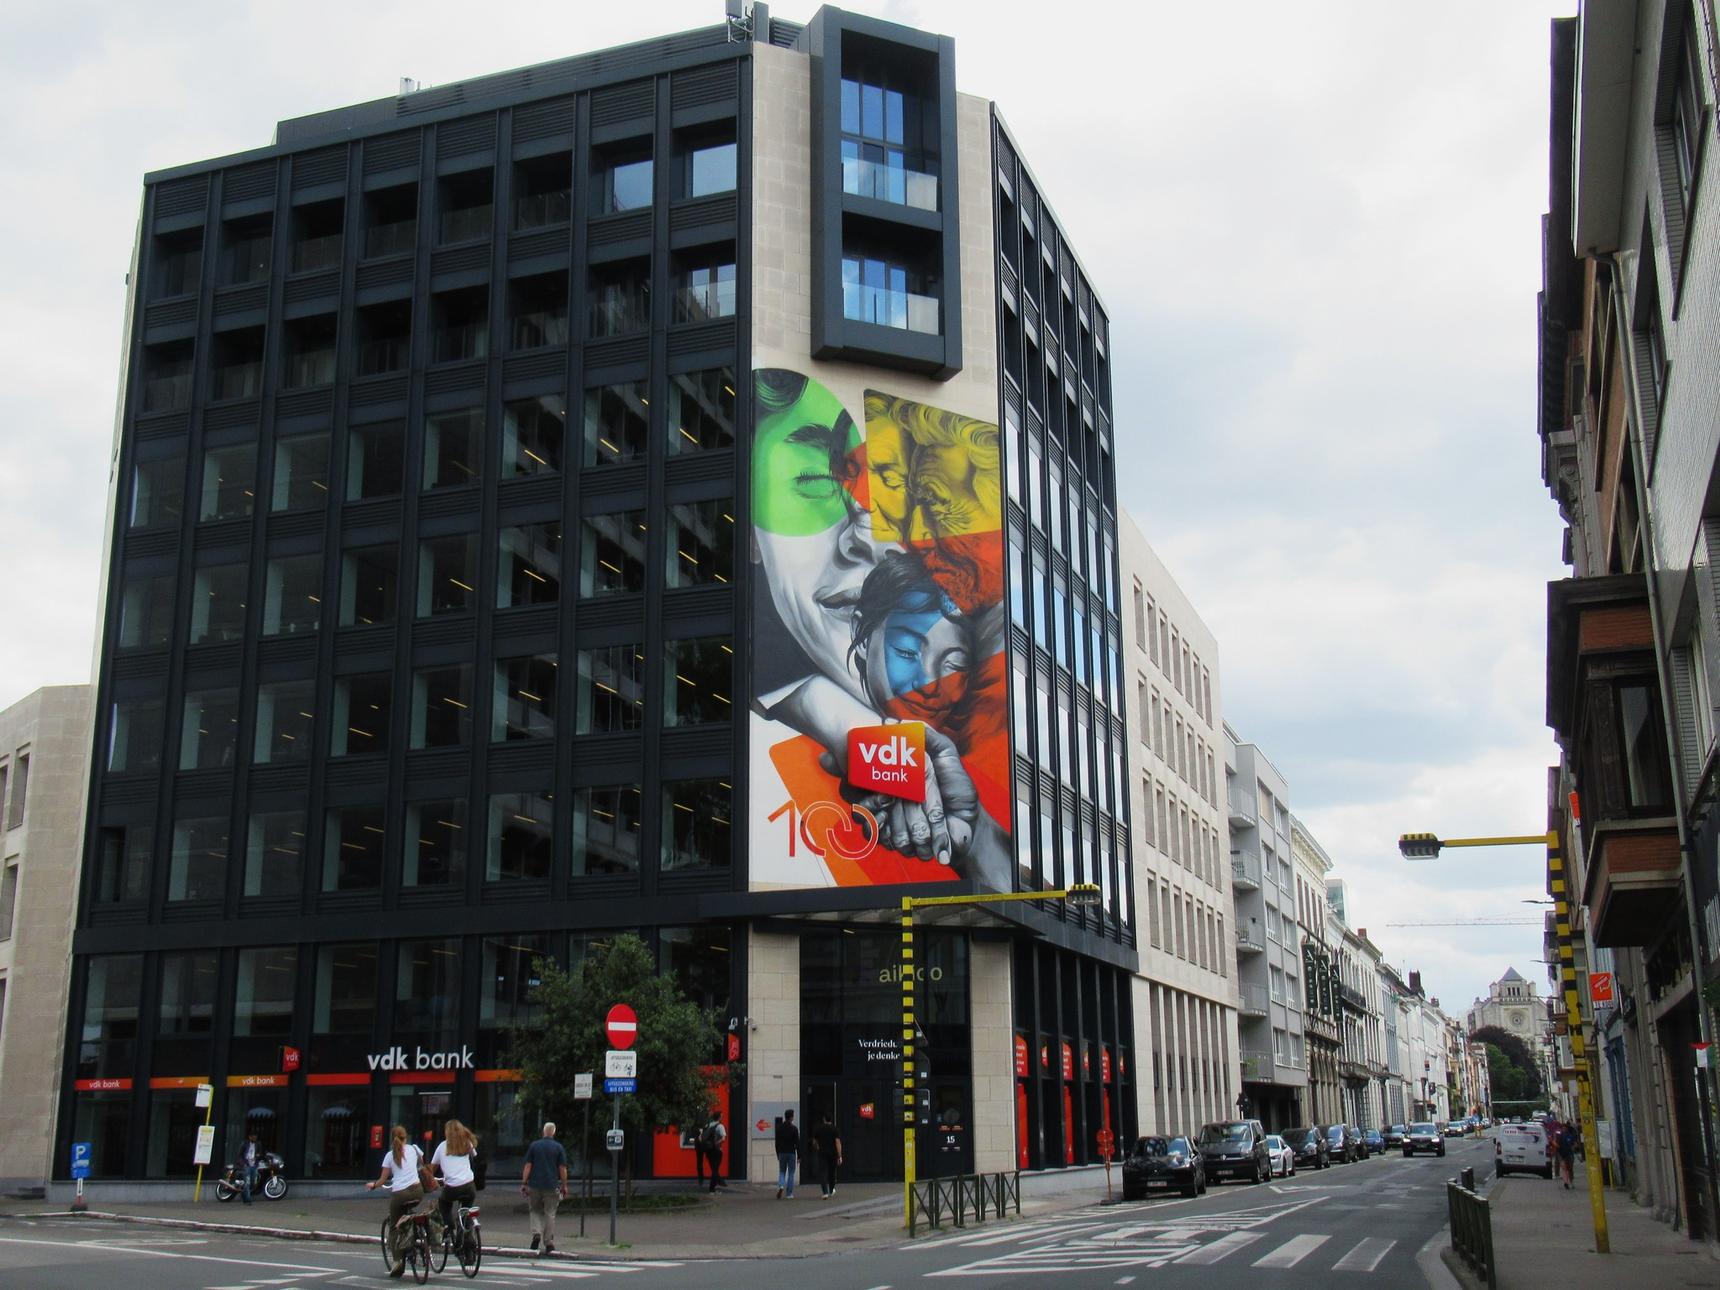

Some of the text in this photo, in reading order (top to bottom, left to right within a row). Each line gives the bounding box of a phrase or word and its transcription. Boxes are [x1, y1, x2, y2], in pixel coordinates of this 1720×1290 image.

[858, 736, 918, 767] vdk
[871, 766, 908, 783] bank
[286, 1051, 299, 1062] vdk
[367, 1044, 475, 1071] vdk bank
[89, 1080, 120, 1089] vdk bank
[242, 1076, 275, 1086] vdk bank
[861, 1104, 873, 1112] vdk
[946, 1135, 956, 1144] 15
[75, 1145, 87, 1160] P
